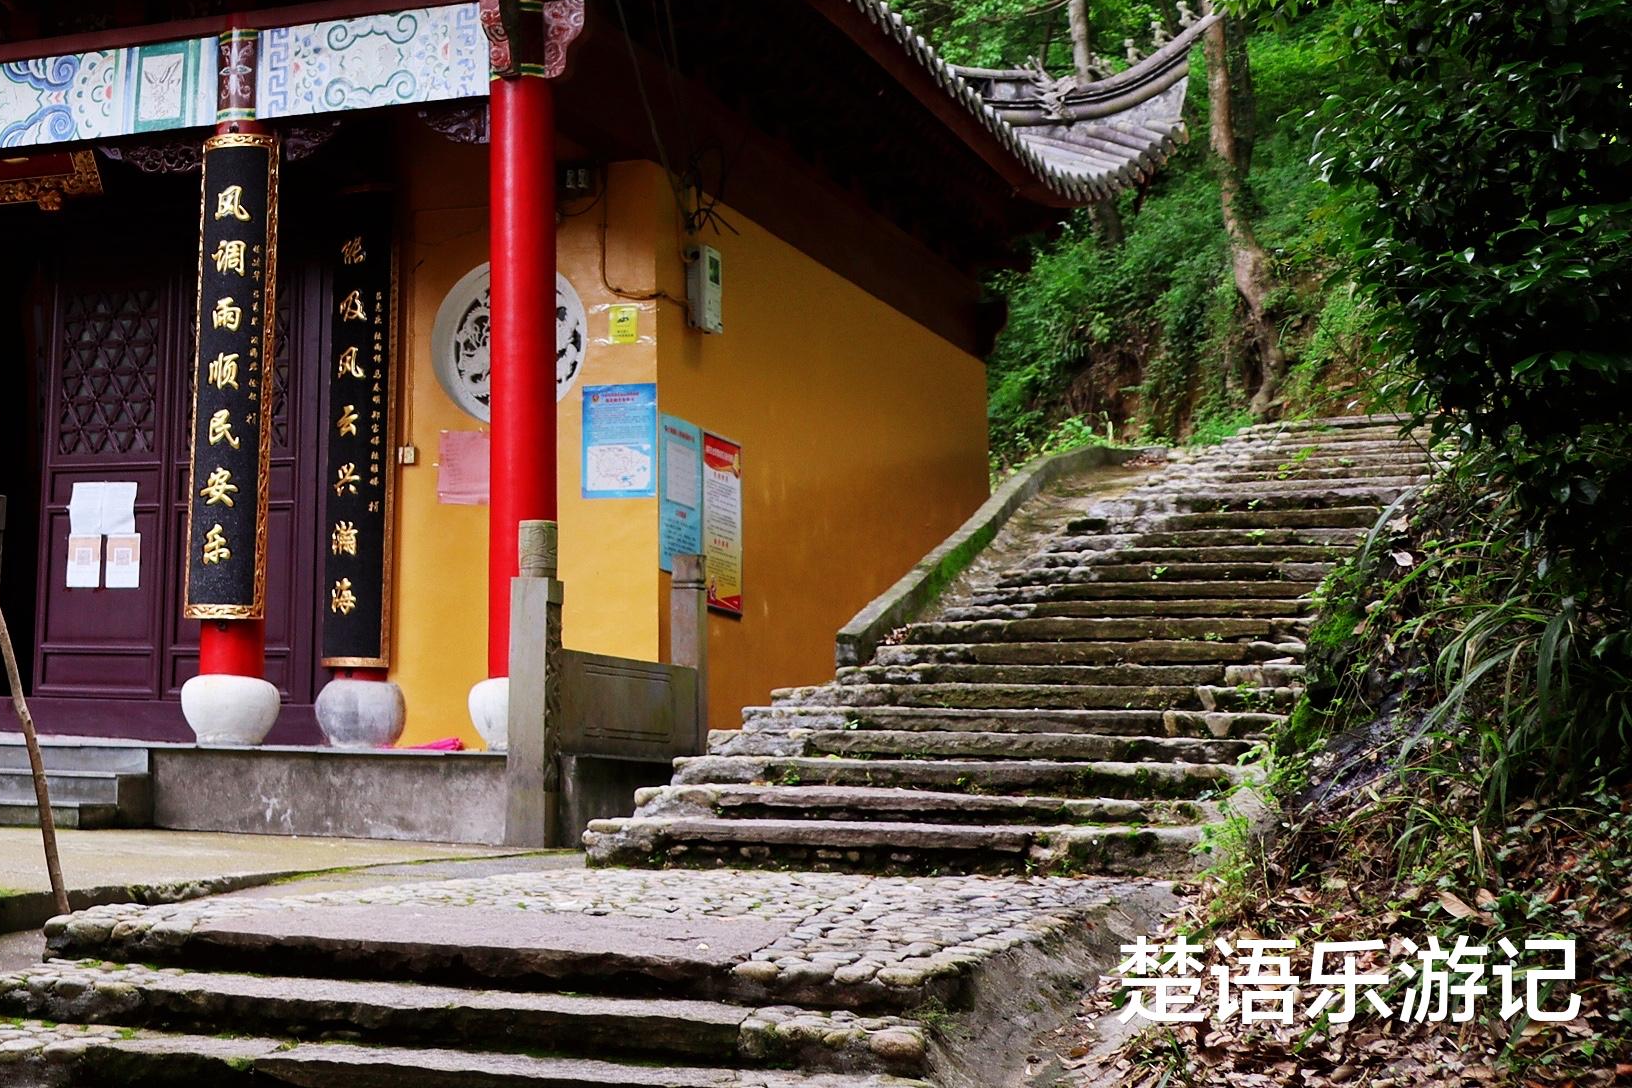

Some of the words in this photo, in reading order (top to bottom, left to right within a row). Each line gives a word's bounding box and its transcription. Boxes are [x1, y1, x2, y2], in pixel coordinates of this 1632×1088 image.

[198, 183, 250, 566] 风调雨顺民安乐
